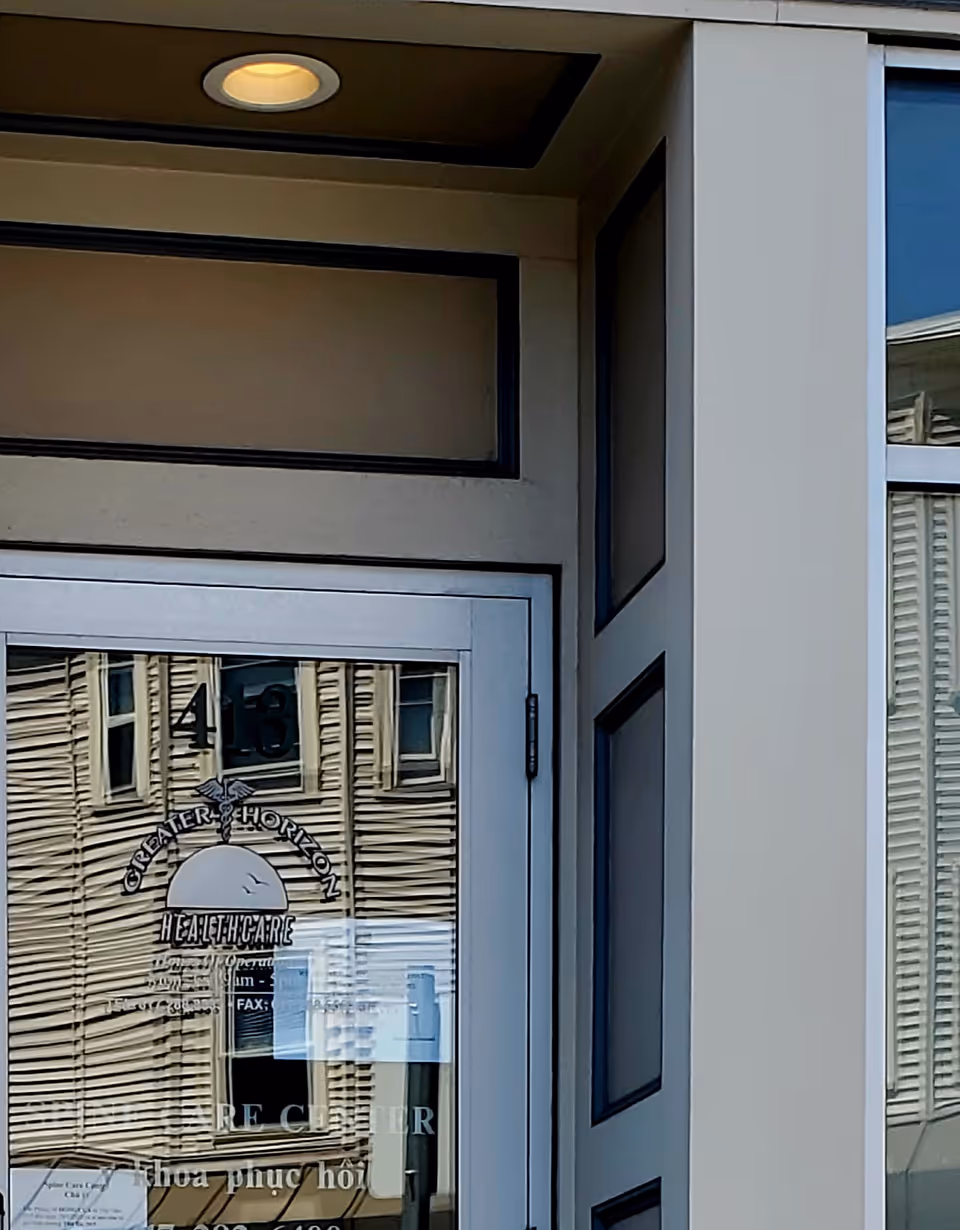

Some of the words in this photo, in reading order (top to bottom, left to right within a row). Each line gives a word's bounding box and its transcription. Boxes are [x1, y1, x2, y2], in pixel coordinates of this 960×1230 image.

[170, 681, 293, 758] 413
[123, 805, 218, 893] GREATER
[241, 805, 340, 898] HORIZON
[160, 912, 295, 945] HEALTHCARE
[280, 1104, 435, 1135] CENTER
[132, 1159, 209, 1188] khoa
[225, 1160, 301, 1197] phục
